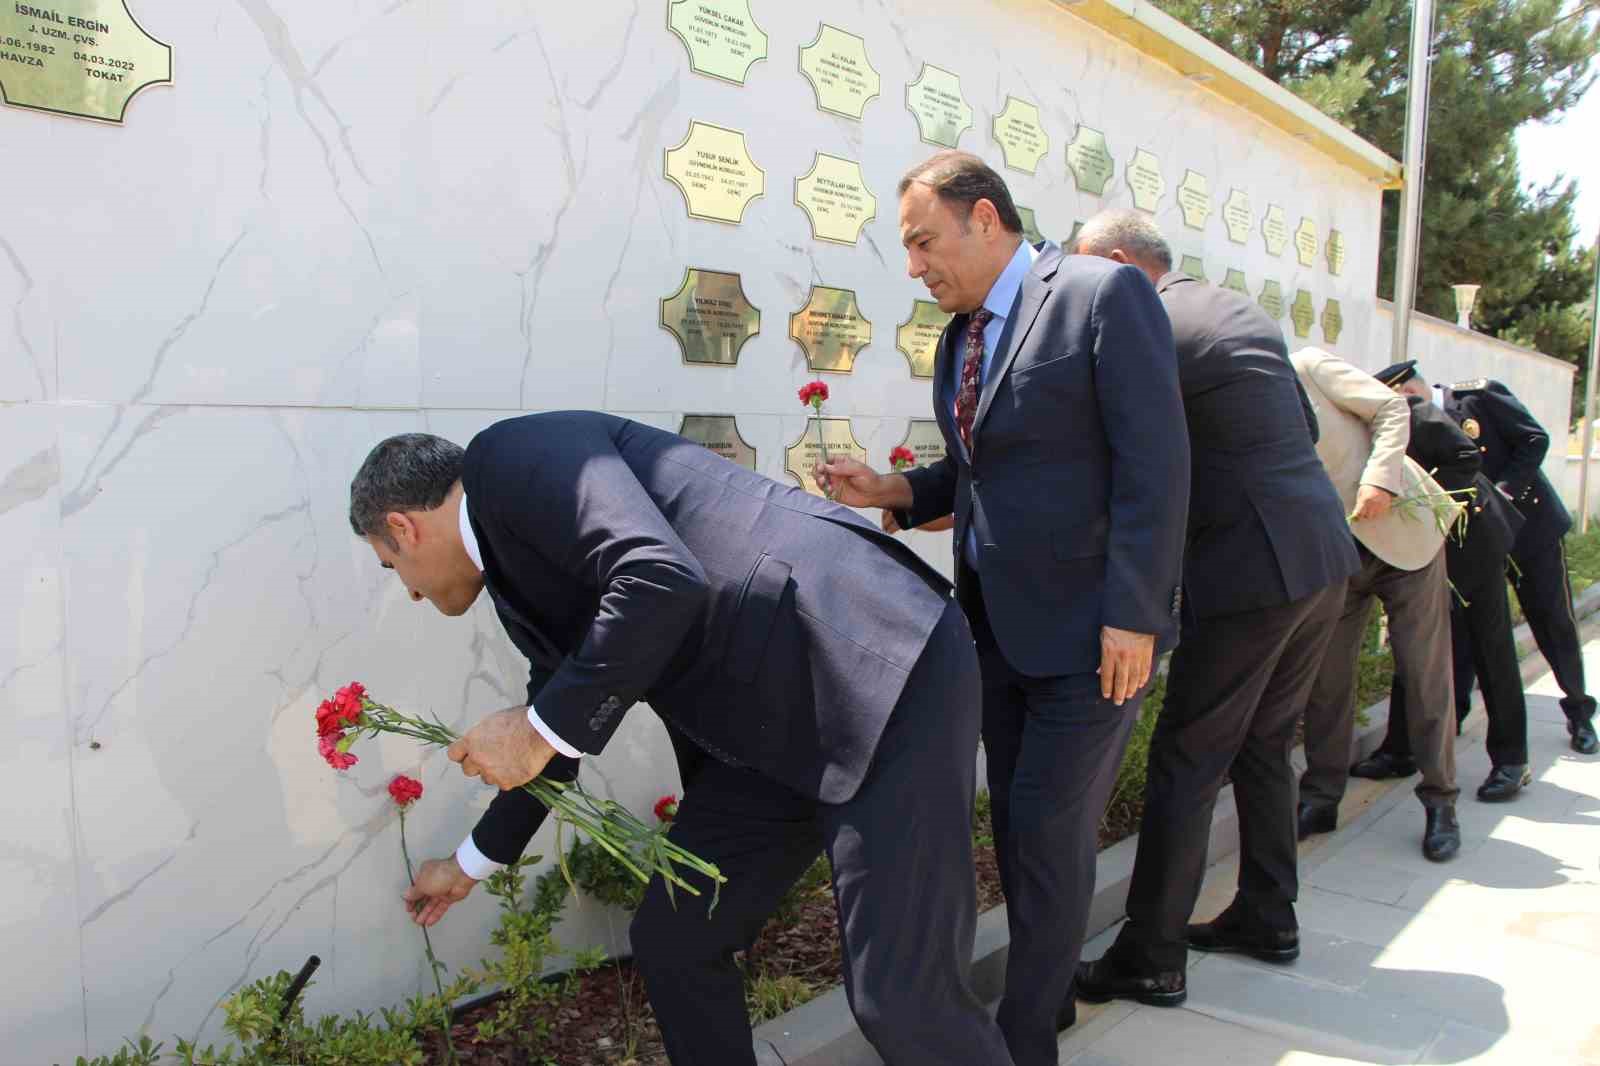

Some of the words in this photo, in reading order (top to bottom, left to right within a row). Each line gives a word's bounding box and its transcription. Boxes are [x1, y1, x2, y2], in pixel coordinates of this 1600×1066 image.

[16, 4, 64, 24] İSMAİL
[68, 16, 109, 34] ERGİN
[28, 25, 38, 34] J.
[42, 26, 70, 40] UZM.
[0, 36, 55, 55] .06.1982
[74, 52, 135, 70] 04.03.2022
[0, 51, 44, 67] HAVZA
[86, 68, 124, 82] TOKAT
